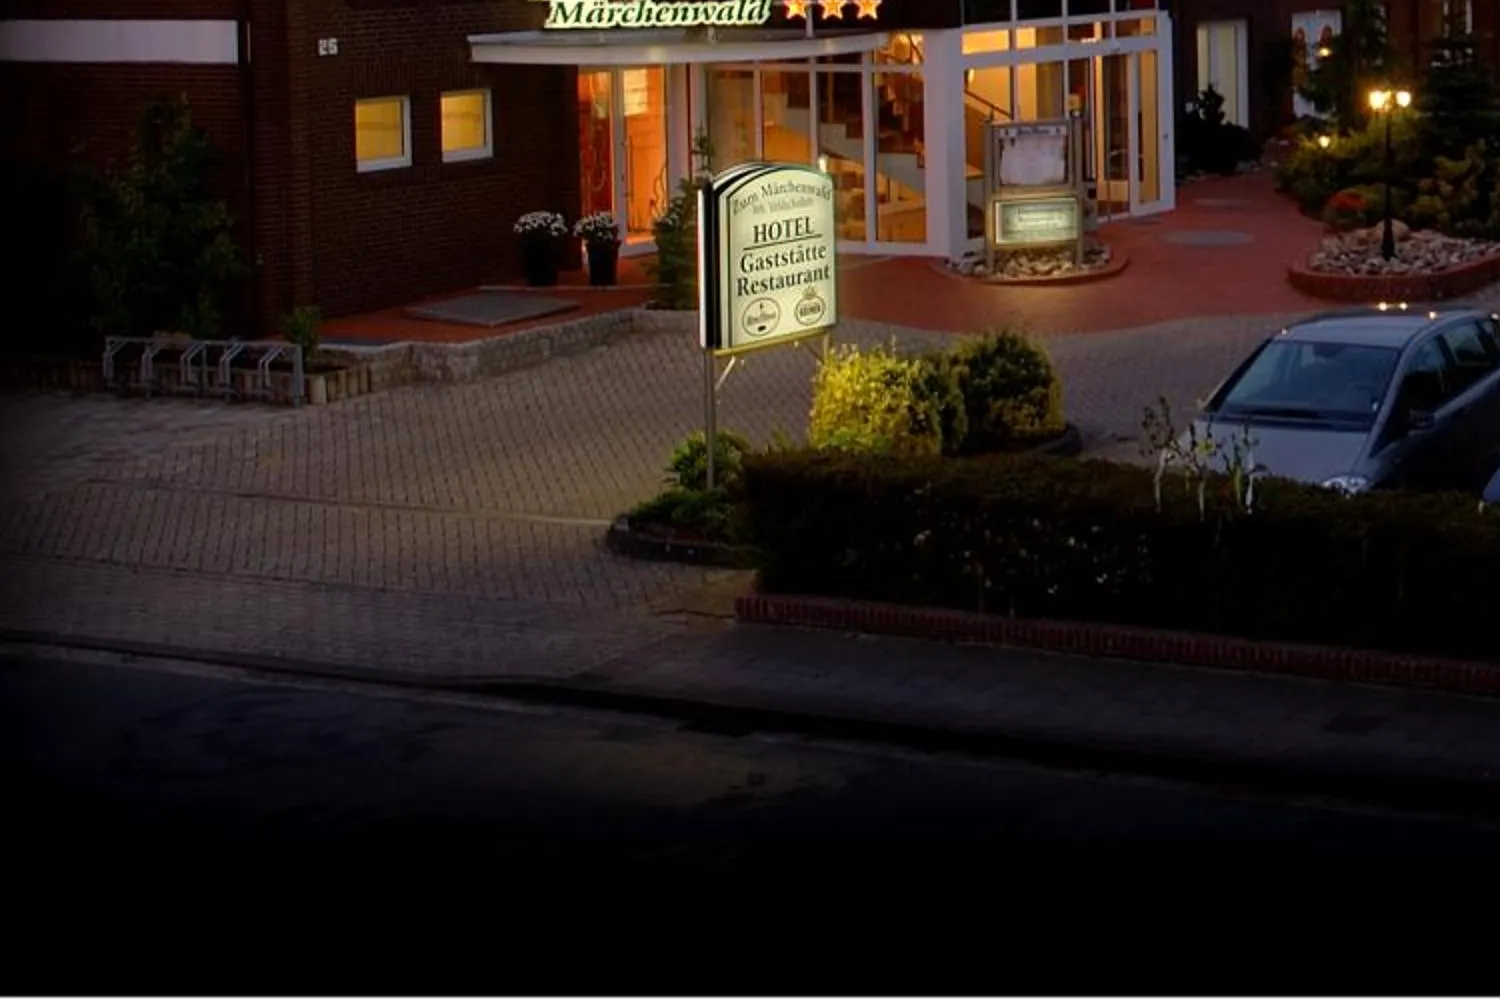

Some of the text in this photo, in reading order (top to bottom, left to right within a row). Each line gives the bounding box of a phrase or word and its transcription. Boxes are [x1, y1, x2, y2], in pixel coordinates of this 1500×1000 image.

[733, 192, 758, 216] Zum
[761, 180, 831, 201] Märchenwald
[753, 215, 815, 244] HOTEL
[740, 244, 828, 274] Gaststätte
[737, 264, 831, 297] Restaurant
